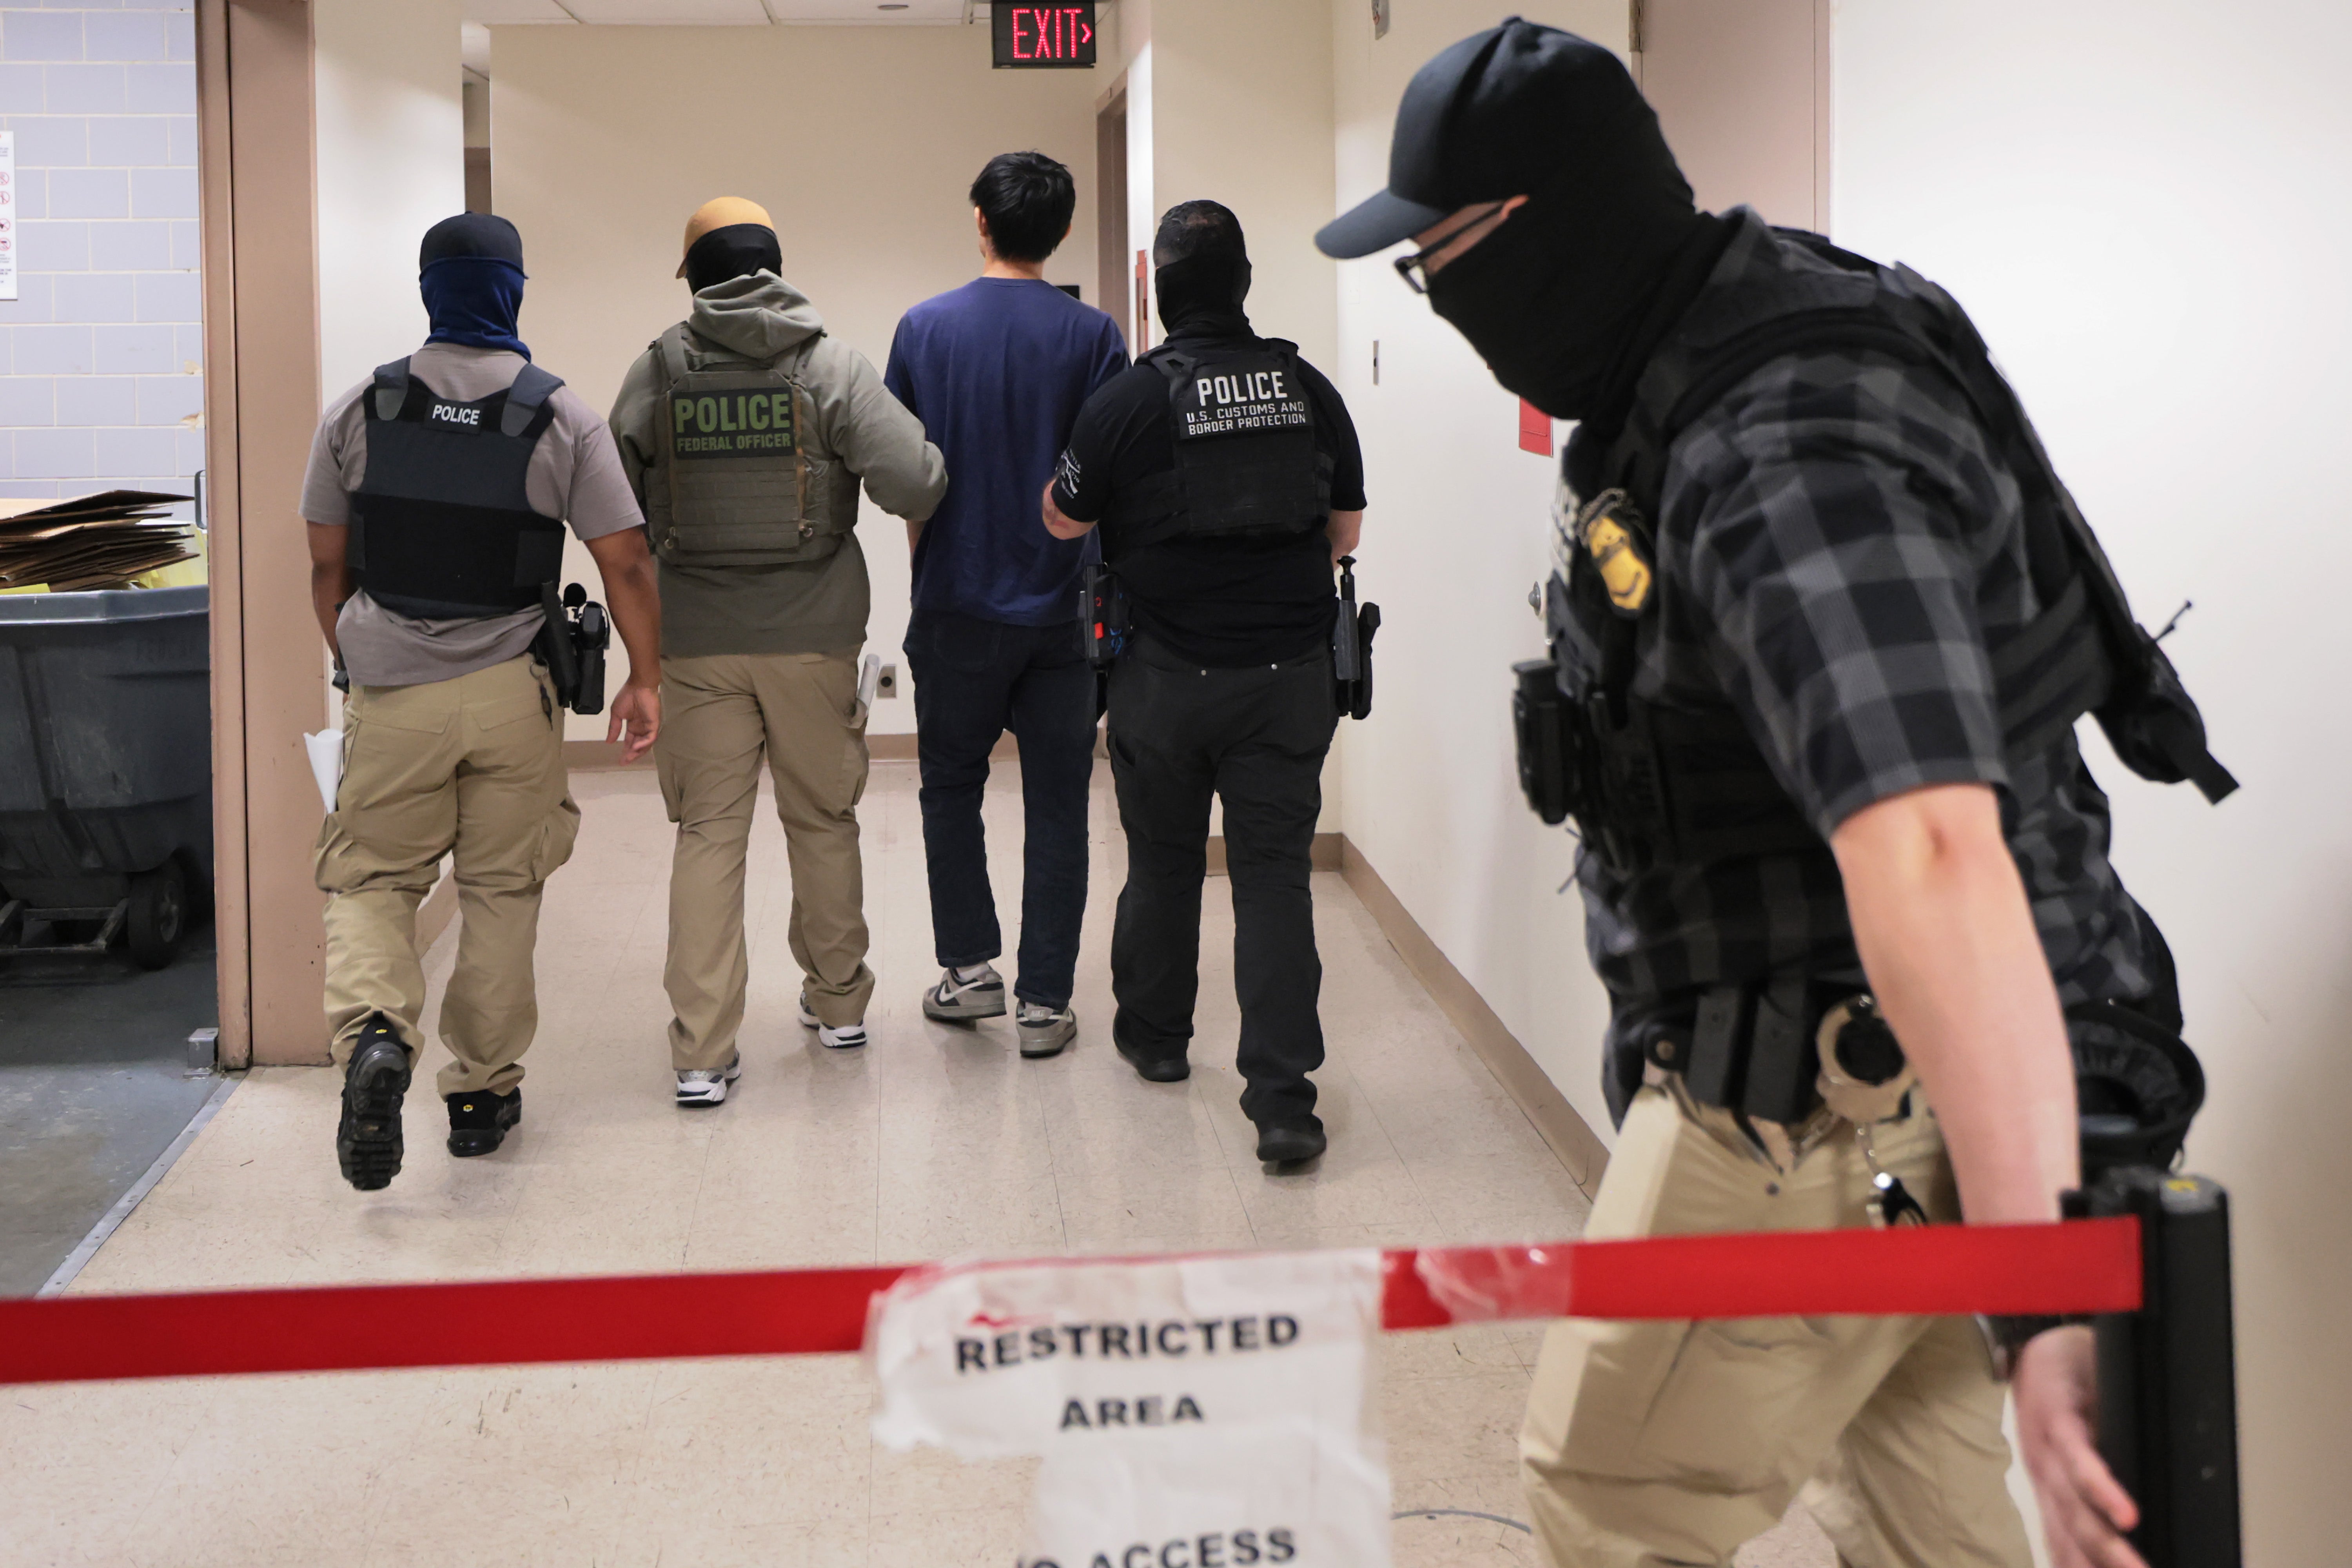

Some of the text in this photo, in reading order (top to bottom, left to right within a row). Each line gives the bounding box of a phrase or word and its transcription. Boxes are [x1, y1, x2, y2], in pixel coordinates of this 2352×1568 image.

[1013, 8, 1083, 58] EXIT
[1197, 372, 1288, 406] POLICE
[432, 405, 480, 425] POLICE
[675, 394, 791, 433] POLICE
[1186, 401, 1304, 423] U.S. CUSTOMS AND
[1188, 414, 1306, 435] BORDER PROTECTION
[677, 433, 791, 452] FEDERAL OFFICER
[955, 1315, 1301, 1372] RESTRICTED
[1059, 1395, 1204, 1430] AREA
